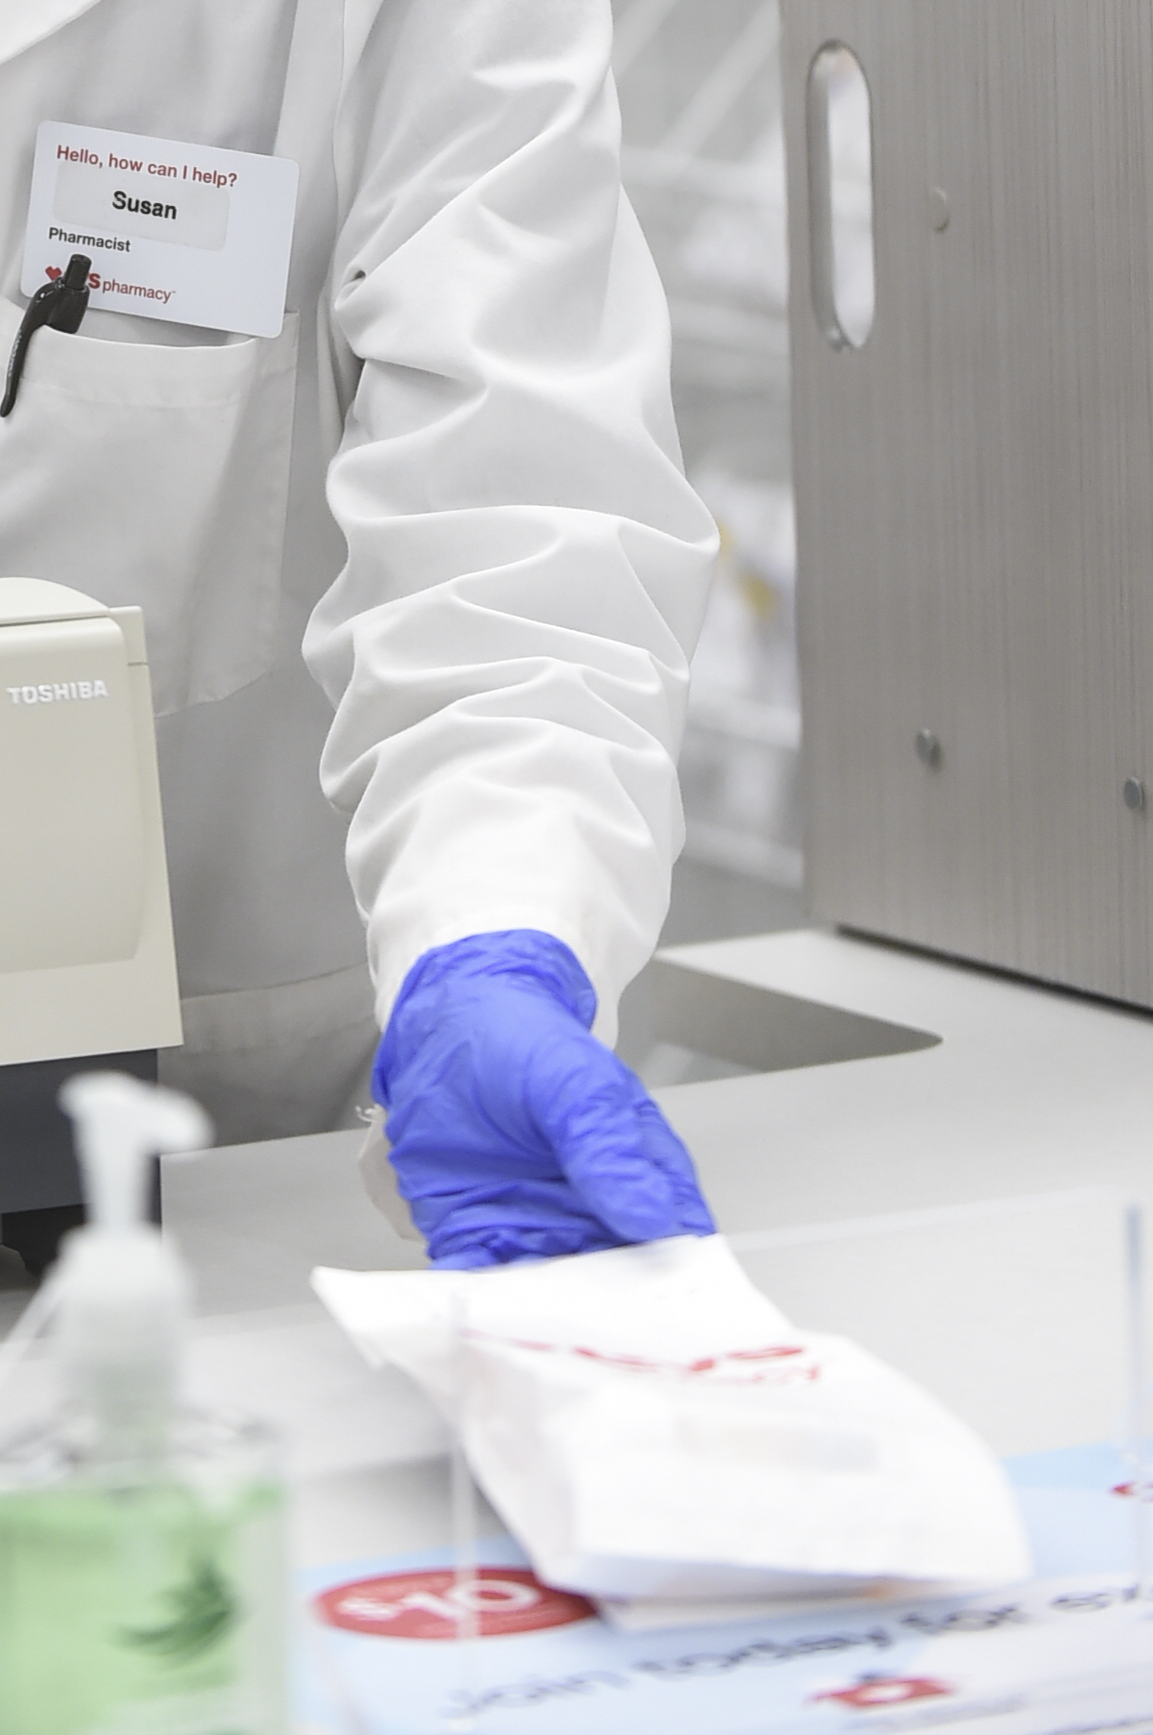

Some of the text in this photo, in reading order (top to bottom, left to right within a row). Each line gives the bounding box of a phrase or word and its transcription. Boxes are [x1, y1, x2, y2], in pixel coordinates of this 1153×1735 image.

[56, 144, 238, 188] Hello, how can I help?
[111, 190, 178, 220] Susan
[48, 226, 131, 253] Pharmacist
[102, 279, 172, 304] pharmacy
[6, 680, 109, 705] TOSHIBA
[337, 1576, 544, 1627] $10
